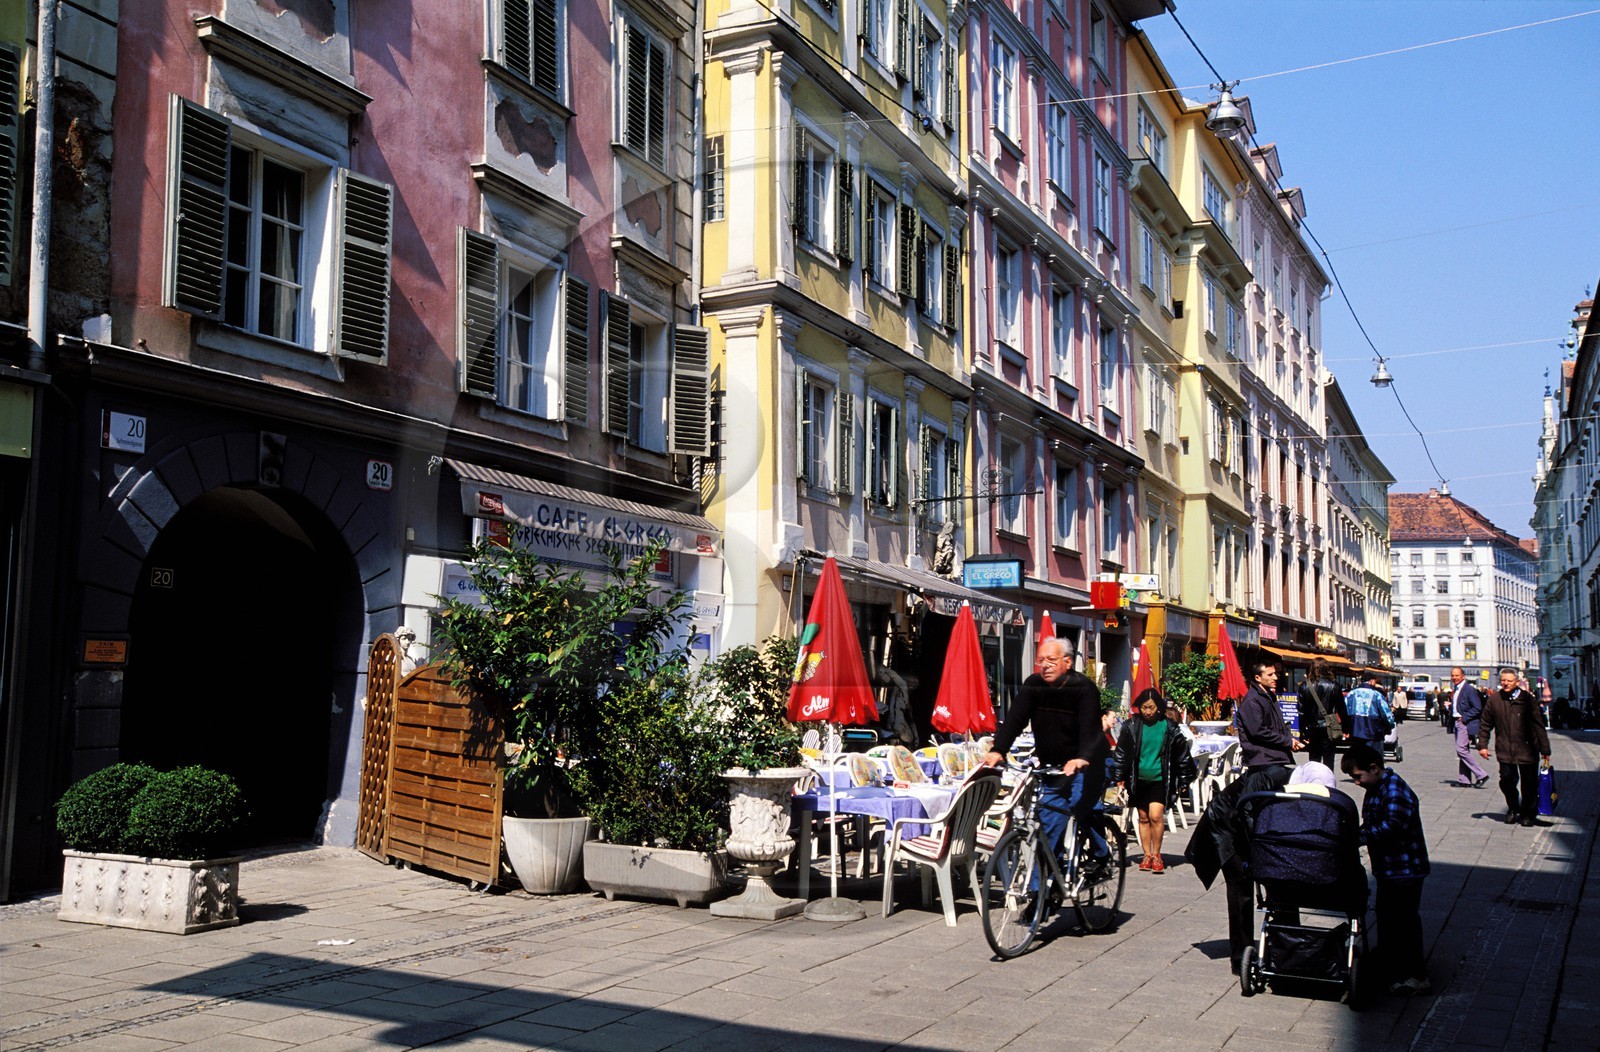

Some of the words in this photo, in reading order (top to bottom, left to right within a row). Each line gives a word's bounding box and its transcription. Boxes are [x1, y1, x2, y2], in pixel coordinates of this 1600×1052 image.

[127, 418, 144, 438] 20
[372, 462, 388, 482] 20
[538, 504, 588, 533] CAFE
[603, 516, 621, 540] EL
[624, 519, 673, 549] GRECO
[153, 571, 171, 585] 20
[984, 571, 1012, 580] GRECO
